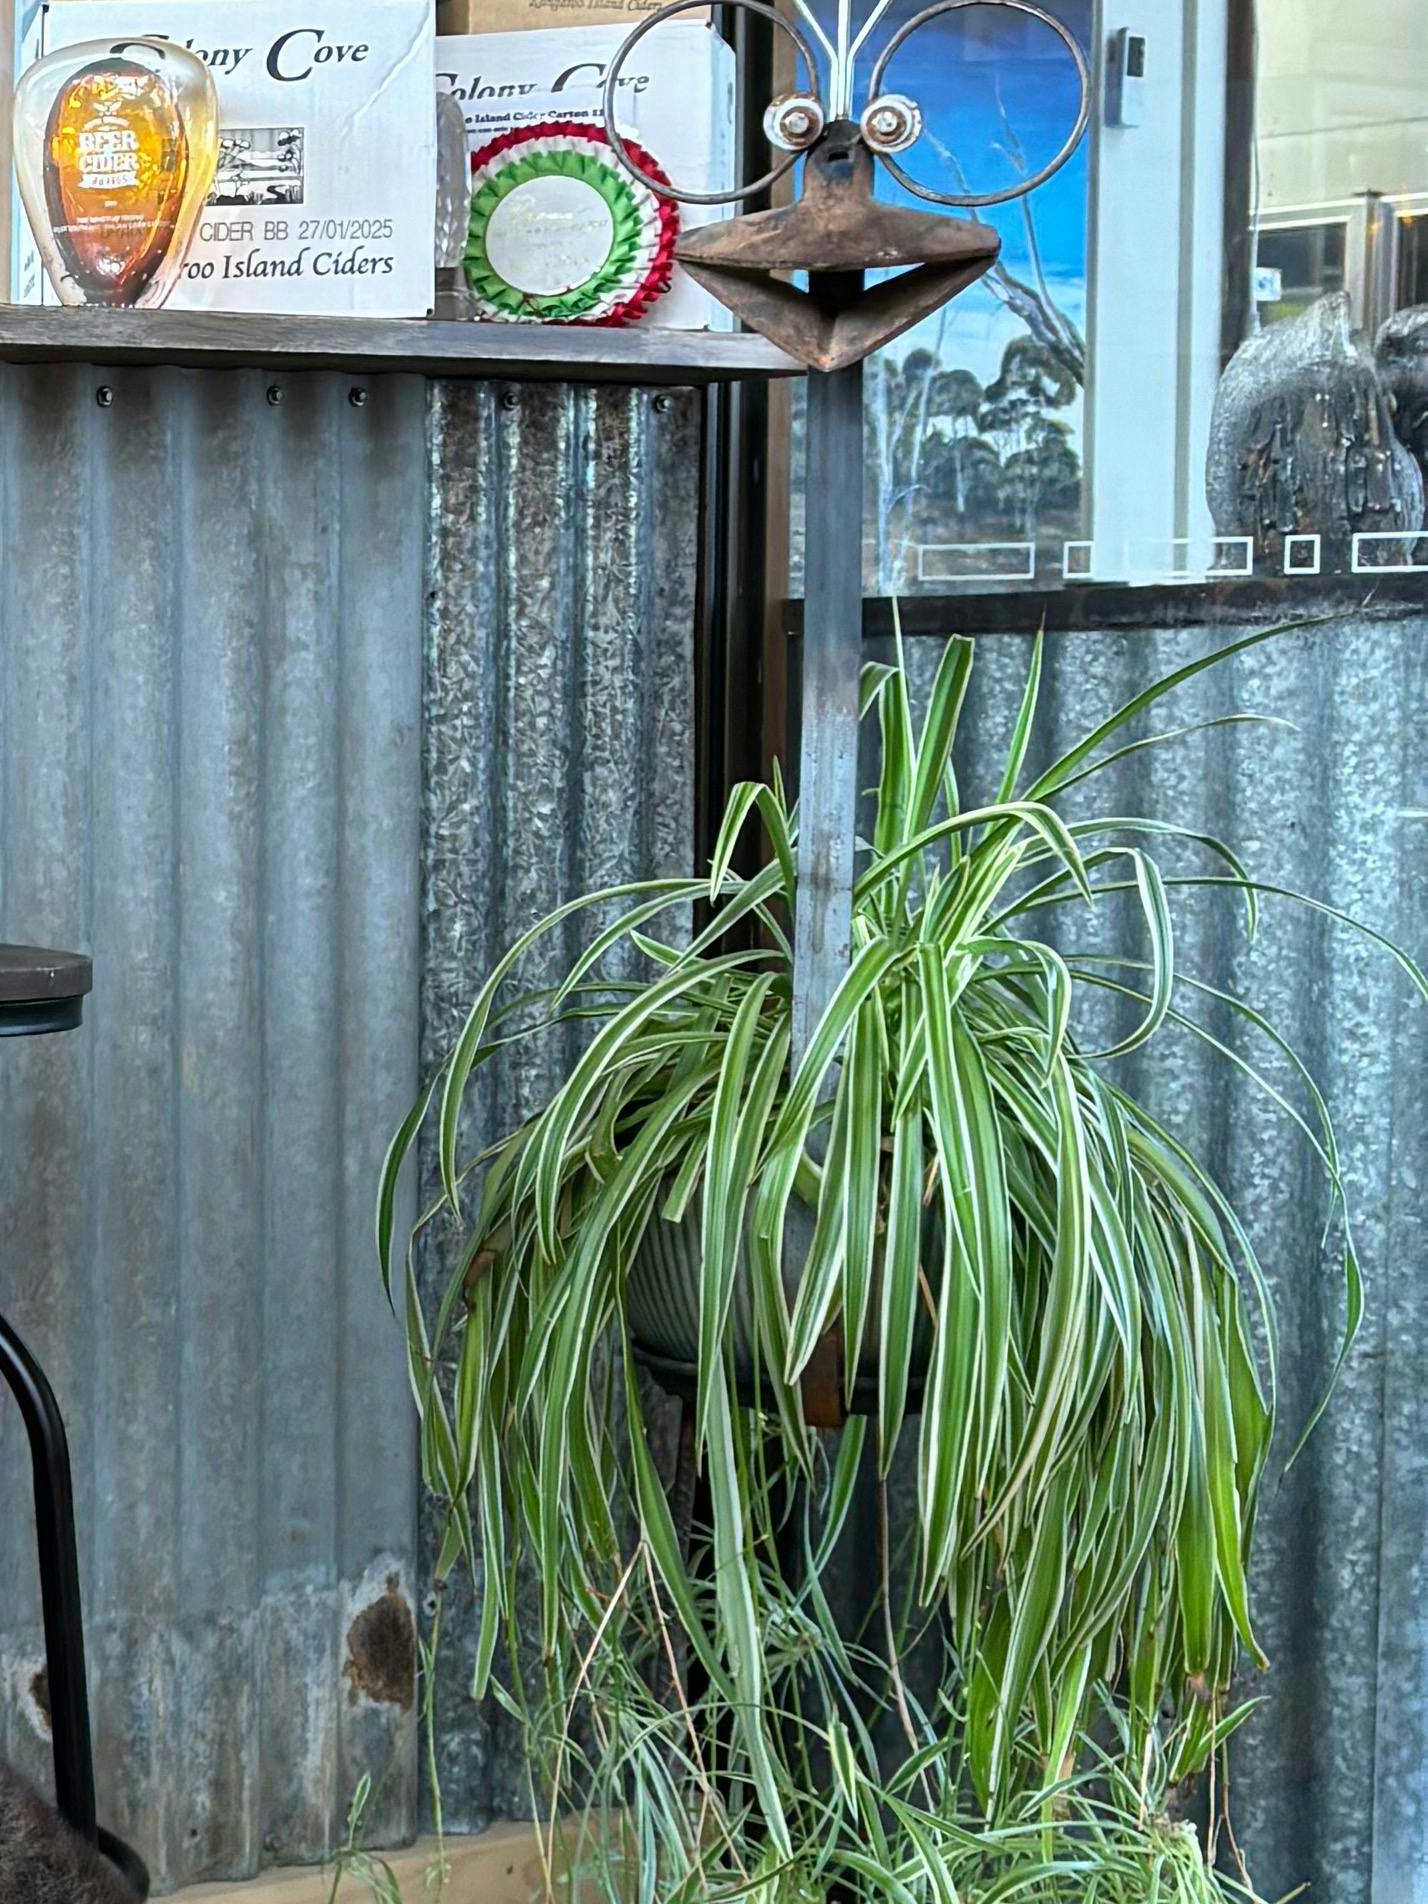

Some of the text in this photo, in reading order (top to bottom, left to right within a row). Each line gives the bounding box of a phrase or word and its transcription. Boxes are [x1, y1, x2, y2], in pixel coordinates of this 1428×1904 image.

[265, 29, 370, 82] Cove
[474, 112, 511, 124] Island
[77, 129, 140, 154] BEER
[78, 151, 141, 174] CIDER
[199, 220, 254, 243] CIDER
[263, 220, 289, 241] BB
[297, 218, 394, 241] 27/01/2025
[221, 247, 303, 280] Island
[312, 244, 395, 276] Ciders
